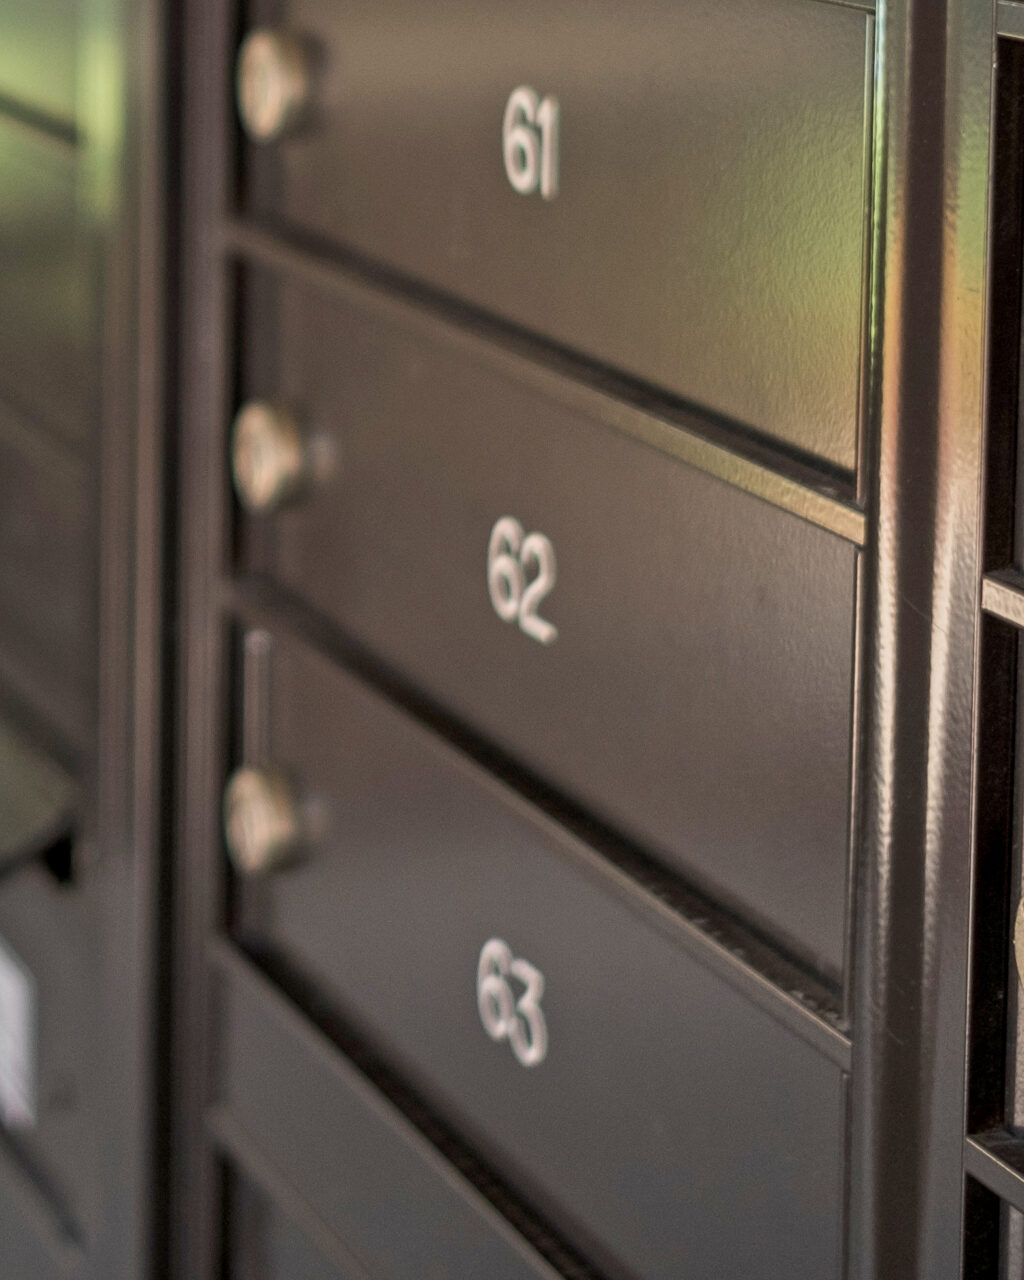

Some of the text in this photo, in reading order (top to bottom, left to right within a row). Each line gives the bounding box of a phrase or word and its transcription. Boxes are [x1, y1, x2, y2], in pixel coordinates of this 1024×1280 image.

[502, 84, 560, 199] 61
[487, 515, 557, 644] 62
[476, 937, 547, 1067] 63
